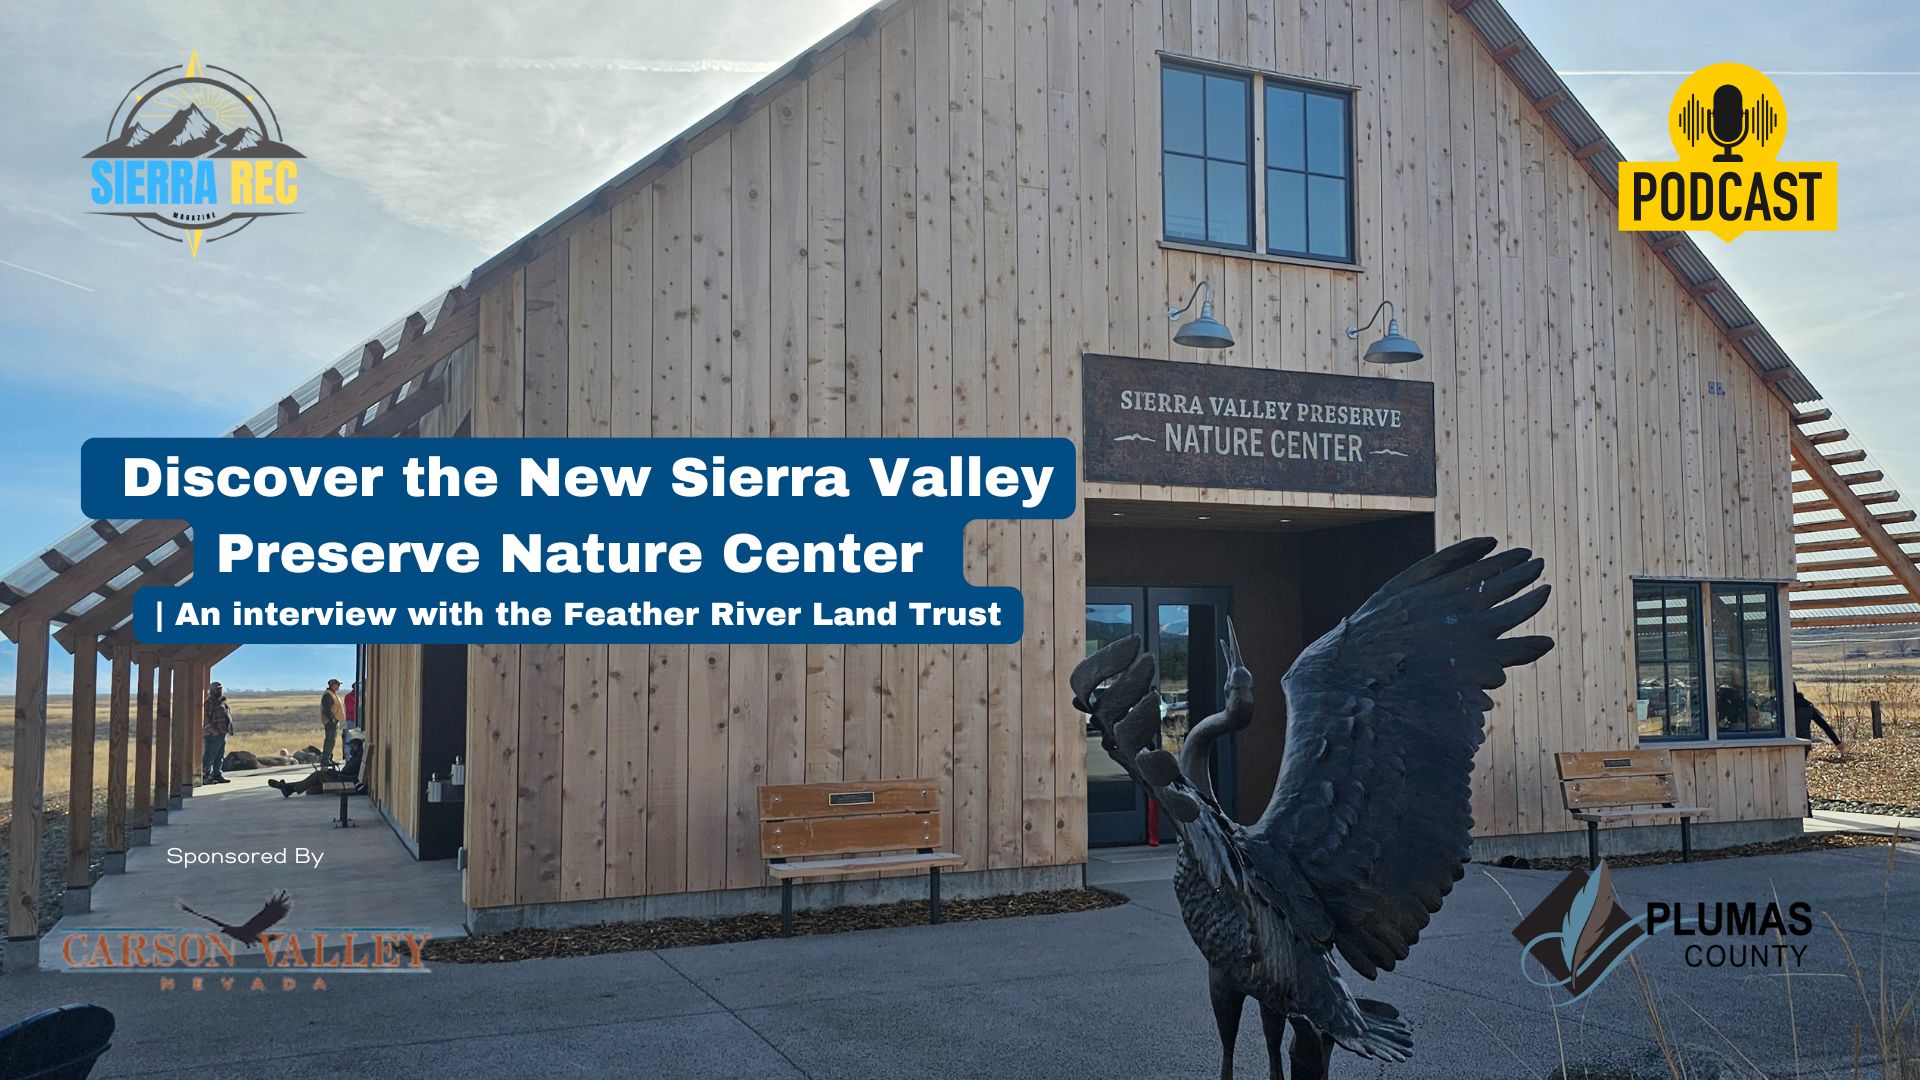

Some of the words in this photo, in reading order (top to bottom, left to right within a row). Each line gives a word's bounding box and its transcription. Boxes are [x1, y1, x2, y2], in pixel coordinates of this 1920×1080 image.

[1120, 390, 1204, 415] SIERRA
[1209, 397, 1293, 421] VALLEY
[1297, 404, 1402, 428] PRESERVE
[1165, 422, 1265, 457] NATURE
[1270, 429, 1363, 463] CENTER
